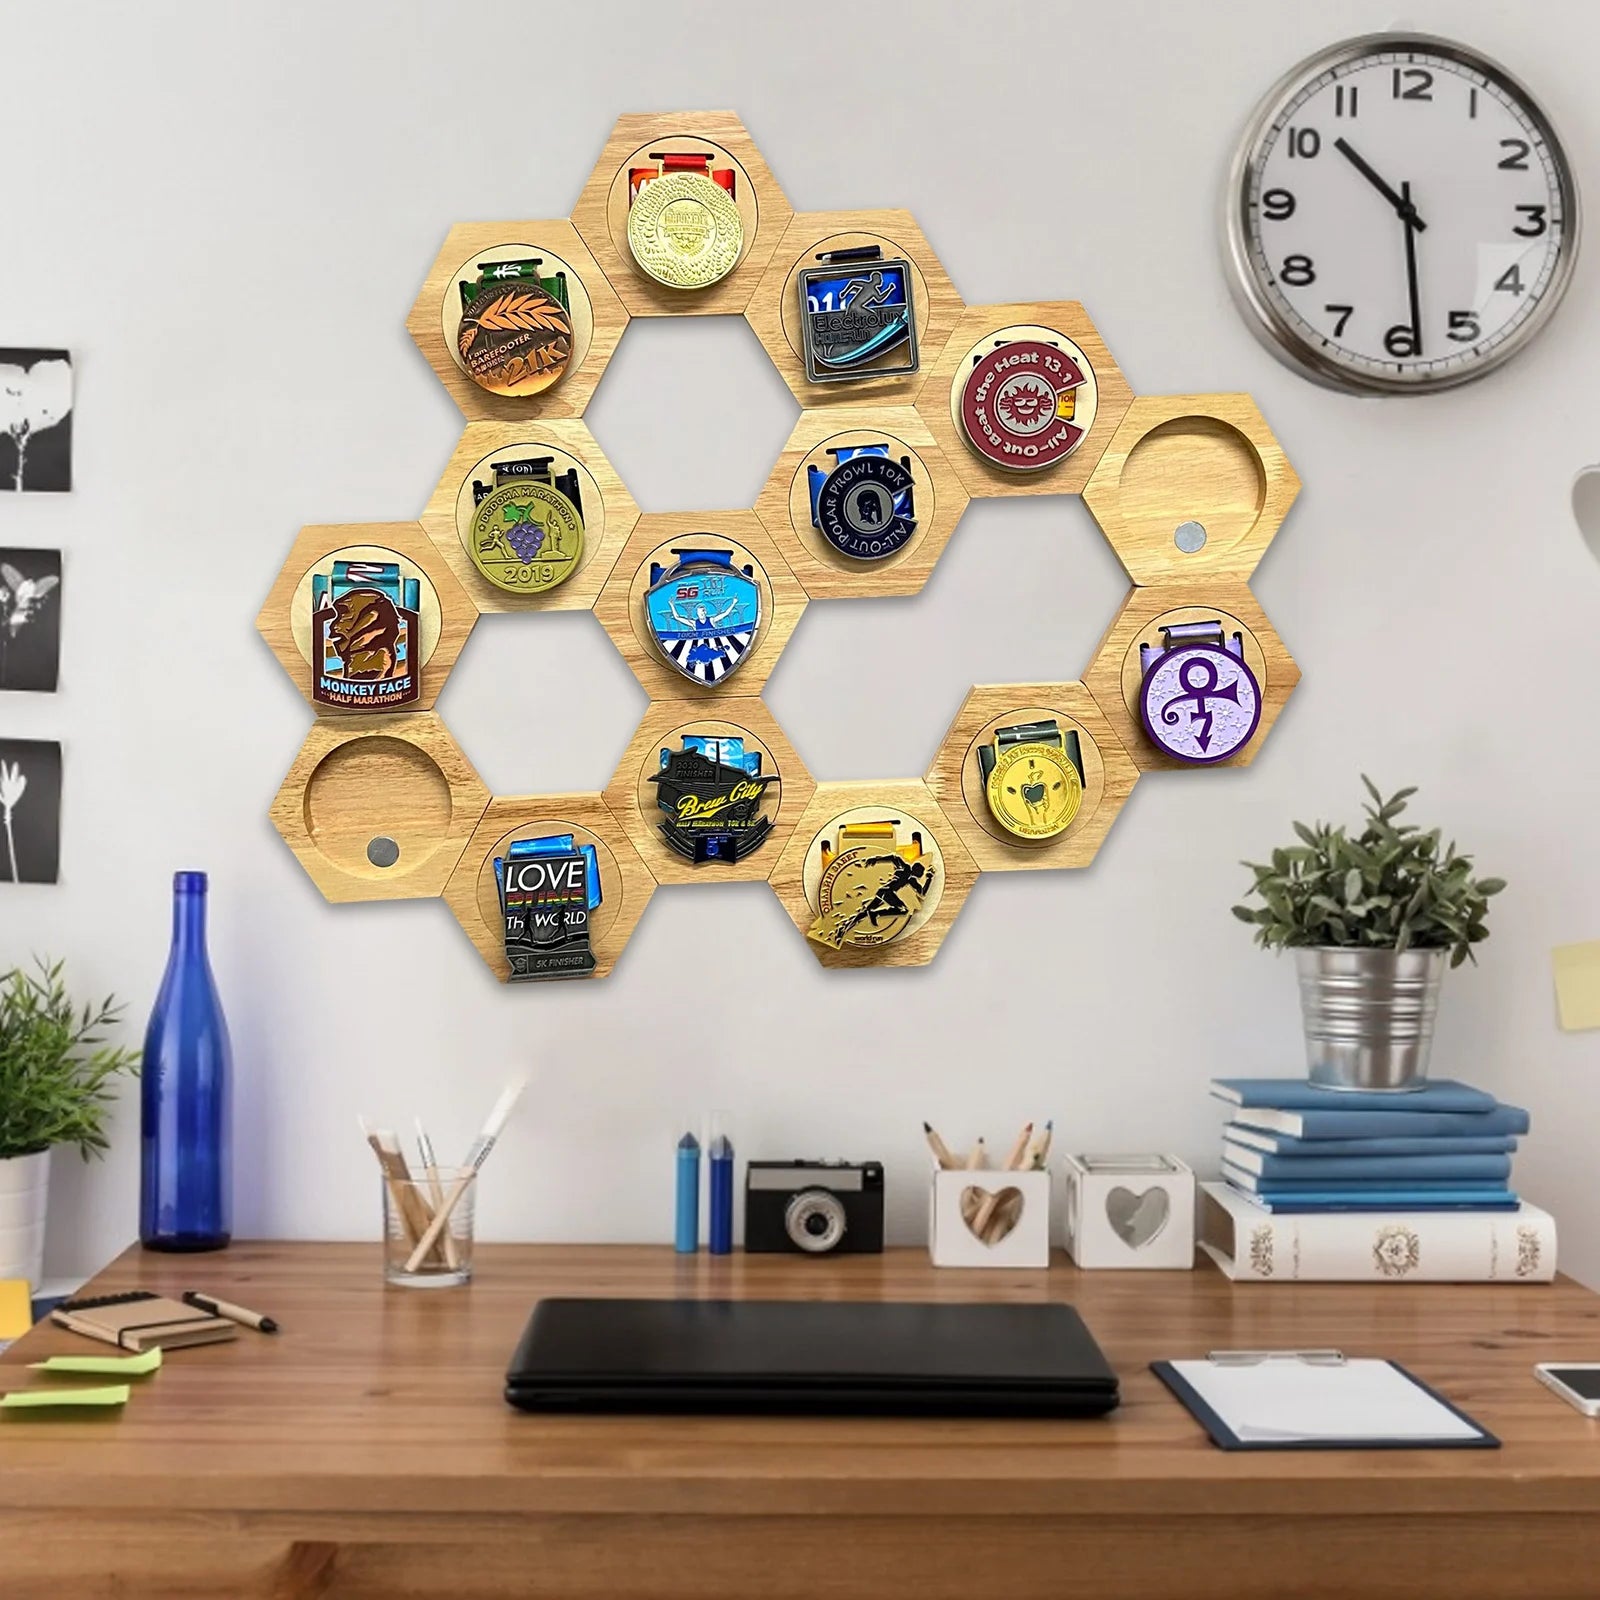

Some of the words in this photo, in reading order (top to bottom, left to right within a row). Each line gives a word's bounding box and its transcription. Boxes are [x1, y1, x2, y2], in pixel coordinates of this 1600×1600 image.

[1392, 67, 1434, 101] 12
[1335, 84, 1358, 118] 11
[1468, 87, 1477, 119] 1
[1287, 126, 1321, 159] 10
[1497, 138, 1531, 170] 2
[1262, 187, 1297, 221] 9
[1511, 204, 1547, 237] 3
[1279, 254, 1316, 287] 8
[1493, 262, 1526, 297] 4
[813, 309, 908, 333] Electrolux
[1324, 303, 1354, 337] 7
[1446, 309, 1481, 342] 5
[470, 333, 532, 368] BAREFOOTER
[1383, 324, 1417, 358] 6
[504, 340, 569, 387] 21K
[993, 351, 1040, 373] Heat
[1043, 355, 1073, 384] 13.1
[975, 371, 996, 402] the
[975, 406, 1002, 446] Beat
[1002, 426, 1068, 457] All-Out
[829, 462, 874, 495] PROWL
[879, 464, 905, 486] 10K
[481, 488, 519, 523] DODOMA
[521, 487, 573, 524] MARATHON
[826, 498, 849, 544] POLAR
[849, 522, 907, 553] ALL-OUT
[503, 564, 555, 584] 2019
[676, 586, 699, 599] SG
[320, 676, 376, 696] MONKEY
[379, 676, 412, 691] FACE
[329, 693, 352, 703] HALF
[353, 691, 403, 705] MARATHON
[676, 769, 715, 778] FINISHER
[677, 795, 728, 819] Brew
[729, 780, 765, 802] City
[505, 861, 585, 893] LOVE
[549, 956, 584, 968] FINISHER
